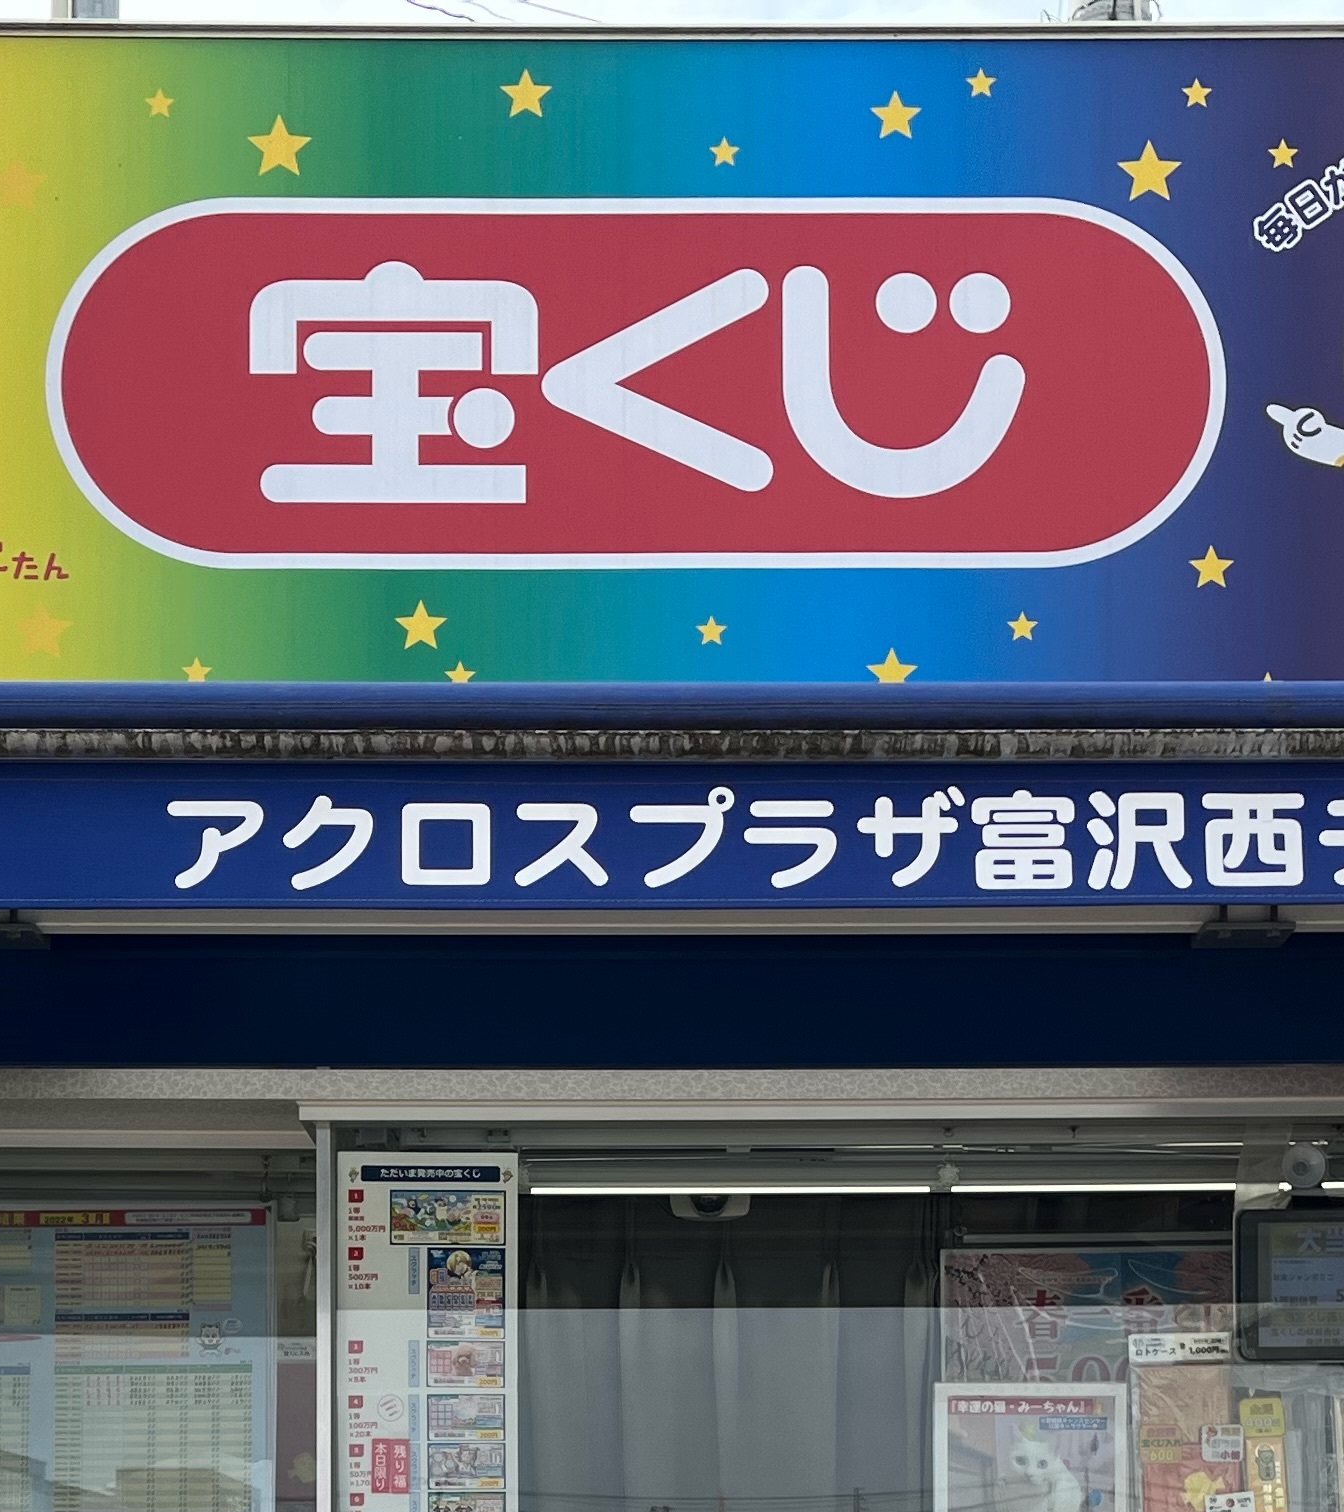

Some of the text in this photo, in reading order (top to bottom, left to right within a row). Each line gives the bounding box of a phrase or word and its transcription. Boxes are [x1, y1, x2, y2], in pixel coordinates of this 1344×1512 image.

[248, 259, 1026, 504] 宝くじ
[380, 1169, 481, 1178] ただいま発売中の宝くじ
[1136, 1348, 1176, 1356] ロトケース
[375, 1443, 387, 1490] 本日限り
[394, 1445, 406, 1488] 残り福
